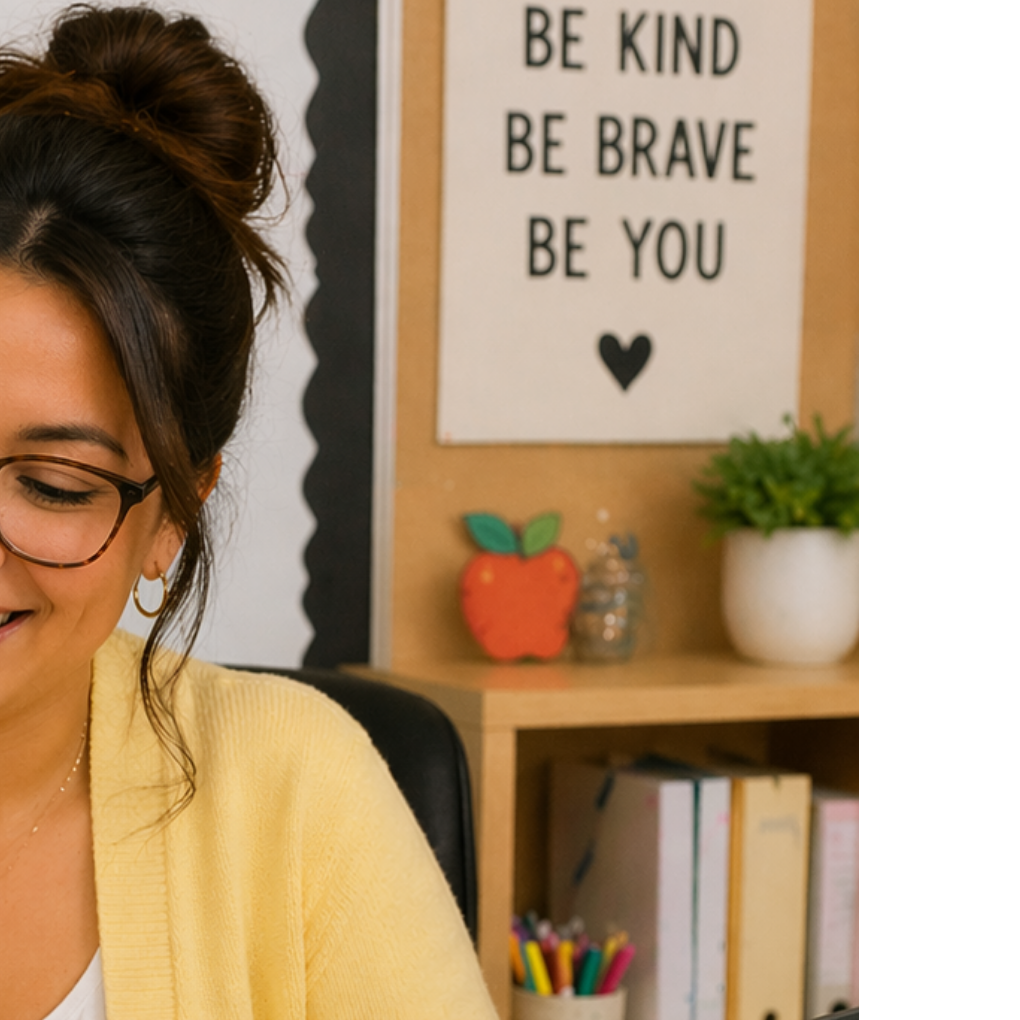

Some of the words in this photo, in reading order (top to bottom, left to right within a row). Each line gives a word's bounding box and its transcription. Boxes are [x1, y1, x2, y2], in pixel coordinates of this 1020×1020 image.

[525, 6, 584, 71] BE
[619, 11, 741, 77] KIND
[505, 111, 566, 175] BE
[597, 114, 756, 182] BRAVE
[527, 216, 589, 279] BE
[622, 218, 726, 281] YOU
